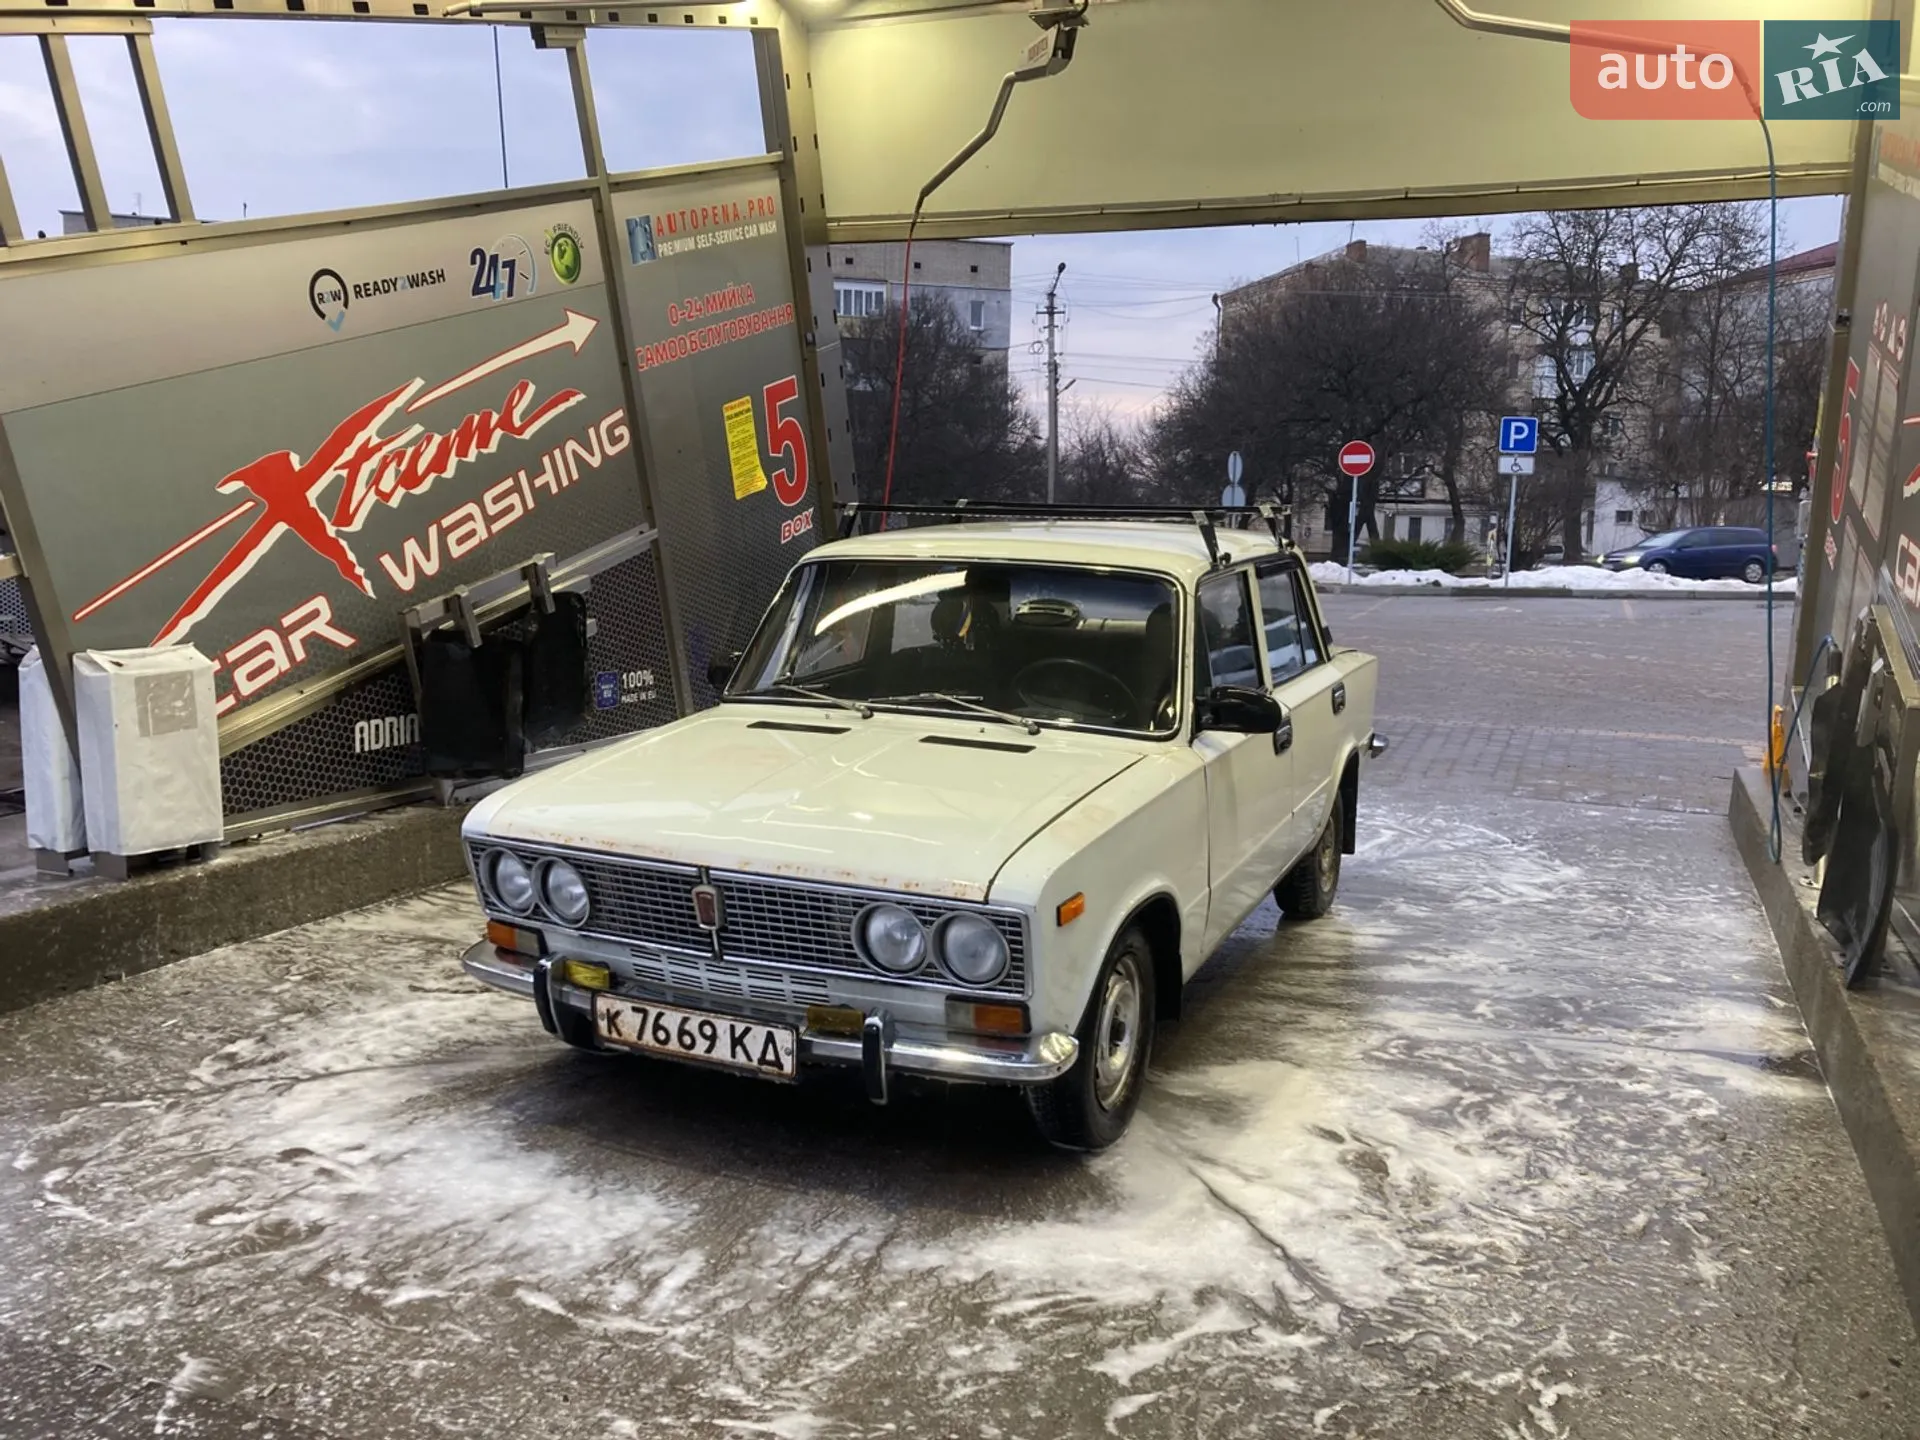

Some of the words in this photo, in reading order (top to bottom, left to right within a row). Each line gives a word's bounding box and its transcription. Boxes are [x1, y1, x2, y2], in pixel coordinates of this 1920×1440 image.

[655, 195, 776, 237] AUTOPENA.PRO
[657, 234, 697, 258] PREMIUM
[696, 225, 744, 249] SELF-SERVICE
[744, 223, 759, 240] CAR
[758, 219, 778, 236] WASH
[353, 268, 446, 300] READY2WASH
[667, 297, 704, 326] 0-24
[704, 280, 756, 317] МИЙКА
[635, 303, 795, 372] САМООБСЛУГОВУВАННЯ
[763, 374, 809, 507] 5
[1509, 421, 1529, 448] P
[780, 507, 814, 544] BOX
[622, 669, 654, 690] 100%
[631, 1005, 718, 1054] 7669
